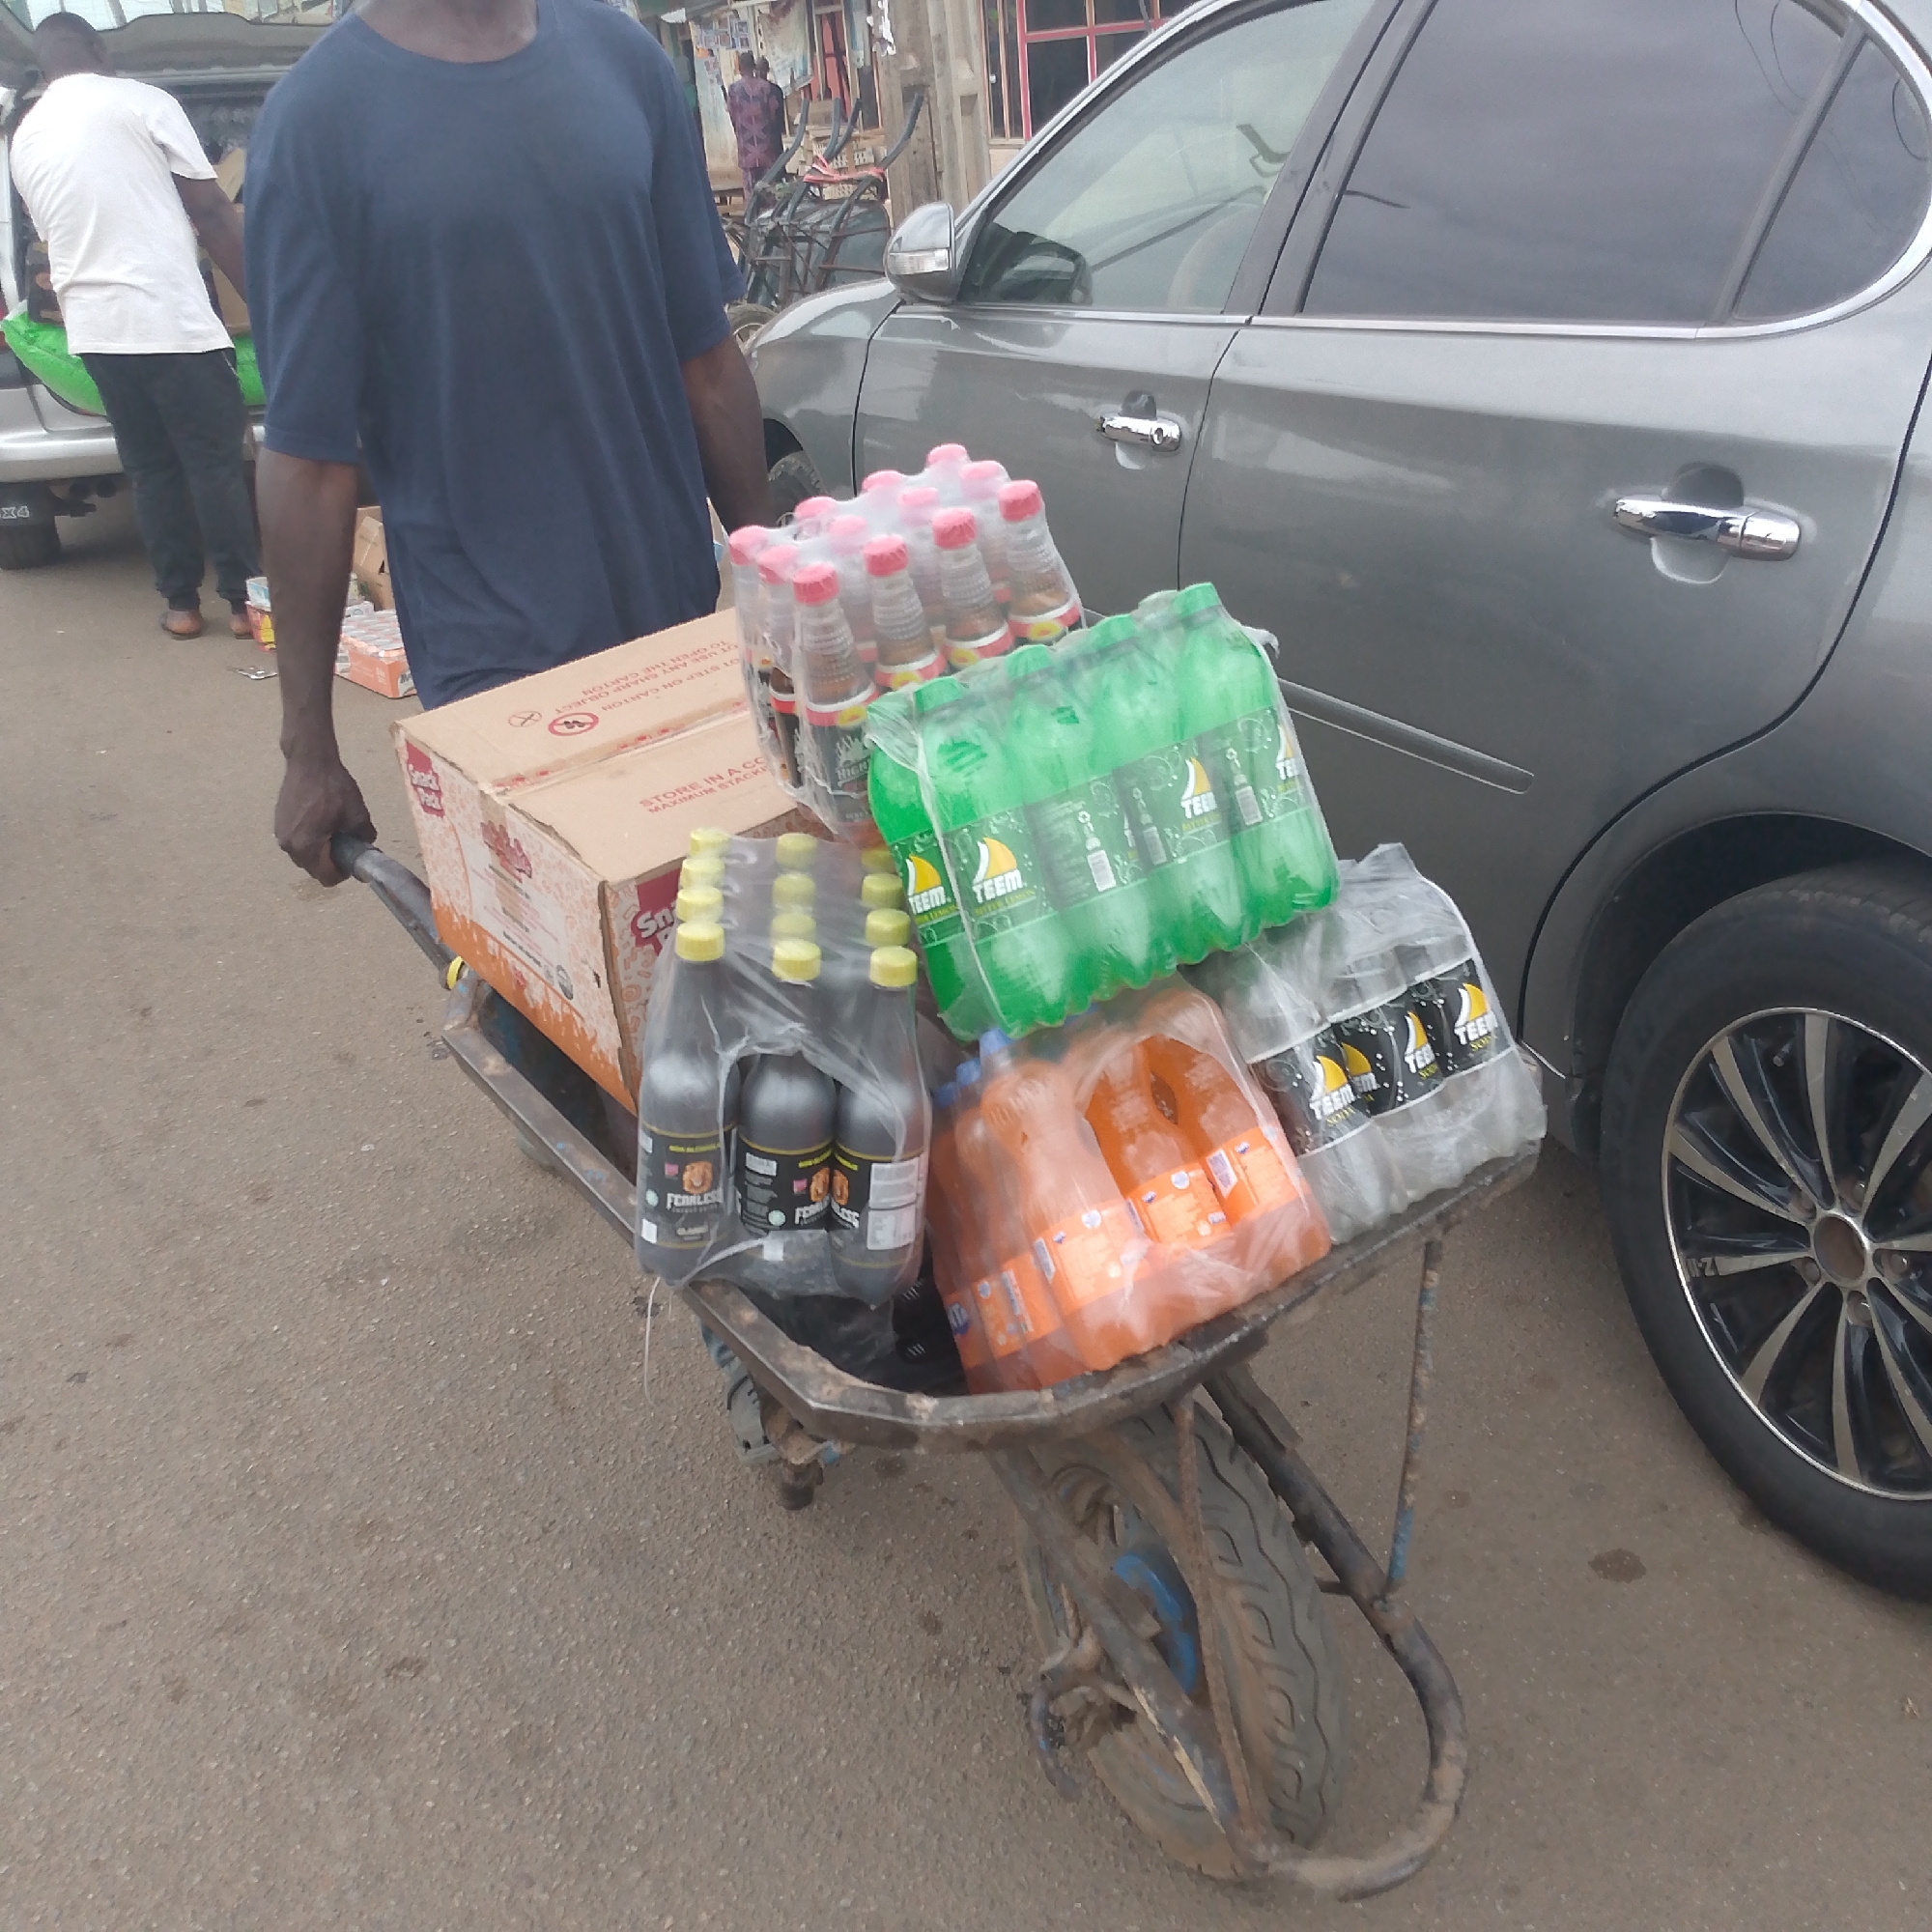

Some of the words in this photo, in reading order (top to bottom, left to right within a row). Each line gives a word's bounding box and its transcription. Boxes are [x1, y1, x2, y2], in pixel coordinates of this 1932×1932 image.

[710, 639, 731, 650] TO
[643, 660, 668, 673] THE
[670, 648, 707, 664] OPEN
[691, 651, 718, 665] USE
[662, 662, 688, 676] ANY
[687, 666, 721, 681] STEP
[582, 672, 639, 696] CARTON
[612, 673, 658, 693] SHARP
[662, 678, 684, 690] ON
[554, 692, 610, 714] OBJECT
[601, 688, 660, 712] CARTON
[639, 781, 702, 808] STORE
[703, 773, 724, 784] IN
[727, 767, 742, 777] A
[648, 786, 717, 813] MAXIMUM
[973, 869, 1024, 904] TEEM
[908, 885, 946, 916] TEEM
[1310, 1083, 1356, 1121] TEEM
